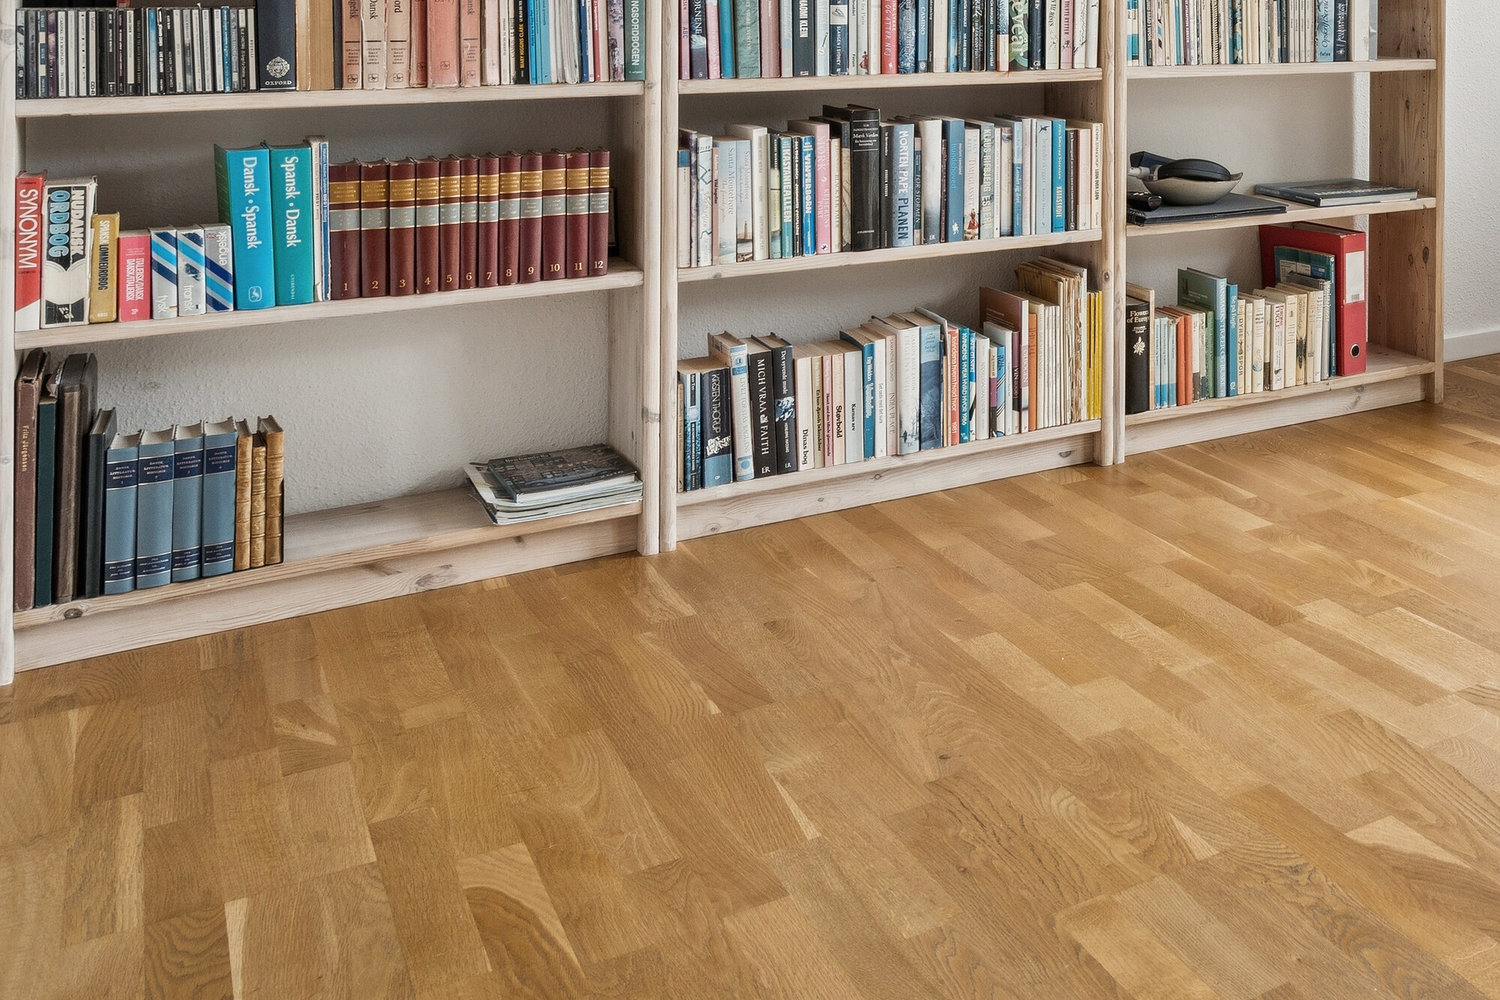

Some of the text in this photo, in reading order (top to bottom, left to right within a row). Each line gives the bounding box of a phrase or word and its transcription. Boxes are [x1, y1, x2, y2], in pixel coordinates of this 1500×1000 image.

[799, 19, 808, 38] KLEIN
[727, 147, 736, 215] Santa Montefiore
[782, 148, 792, 222] KASTANIEALLEEN
[804, 153, 812, 214] VINTERBØRN
[897, 130, 909, 240] MORTEN PAPE PLANEN
[982, 129, 992, 230] KLAUS RIFBJERG ESBERN
[242, 156, 262, 250] Dansk Spansk
[282, 156, 301, 248] Spansk Dansk
[18, 188, 39, 269] SYNONYM
[49, 190, 71, 258] ORDBOG
[71, 189, 86, 258] NUDANSK
[100, 219, 110, 245] SPANSK
[219, 231, 229, 266] engelsk
[446, 274, 453, 283] 5
[465, 272, 472, 281] 6
[486, 271, 493, 280] 7
[505, 268, 512, 277] 8
[527, 266, 534, 275] 9
[549, 263, 561, 272] 10
[574, 262, 583, 271] 11
[593, 260, 604, 269] 12
[127, 258, 136, 303] DANSK/ITALIENSK
[135, 257, 145, 301] ITALIENSK/DANSK
[343, 282, 349, 291] 1
[372, 281, 379, 289] 2
[399, 279, 406, 288] 3
[424, 276, 431, 286] 4
[157, 294, 168, 312] tysk
[183, 284, 193, 312] fransk
[710, 373, 721, 433] KIRSTEN THORUP
[757, 358, 770, 455] MICH VRAA FAITH
[835, 405, 843, 438] Støvbold
[801, 450, 810, 465] bog
